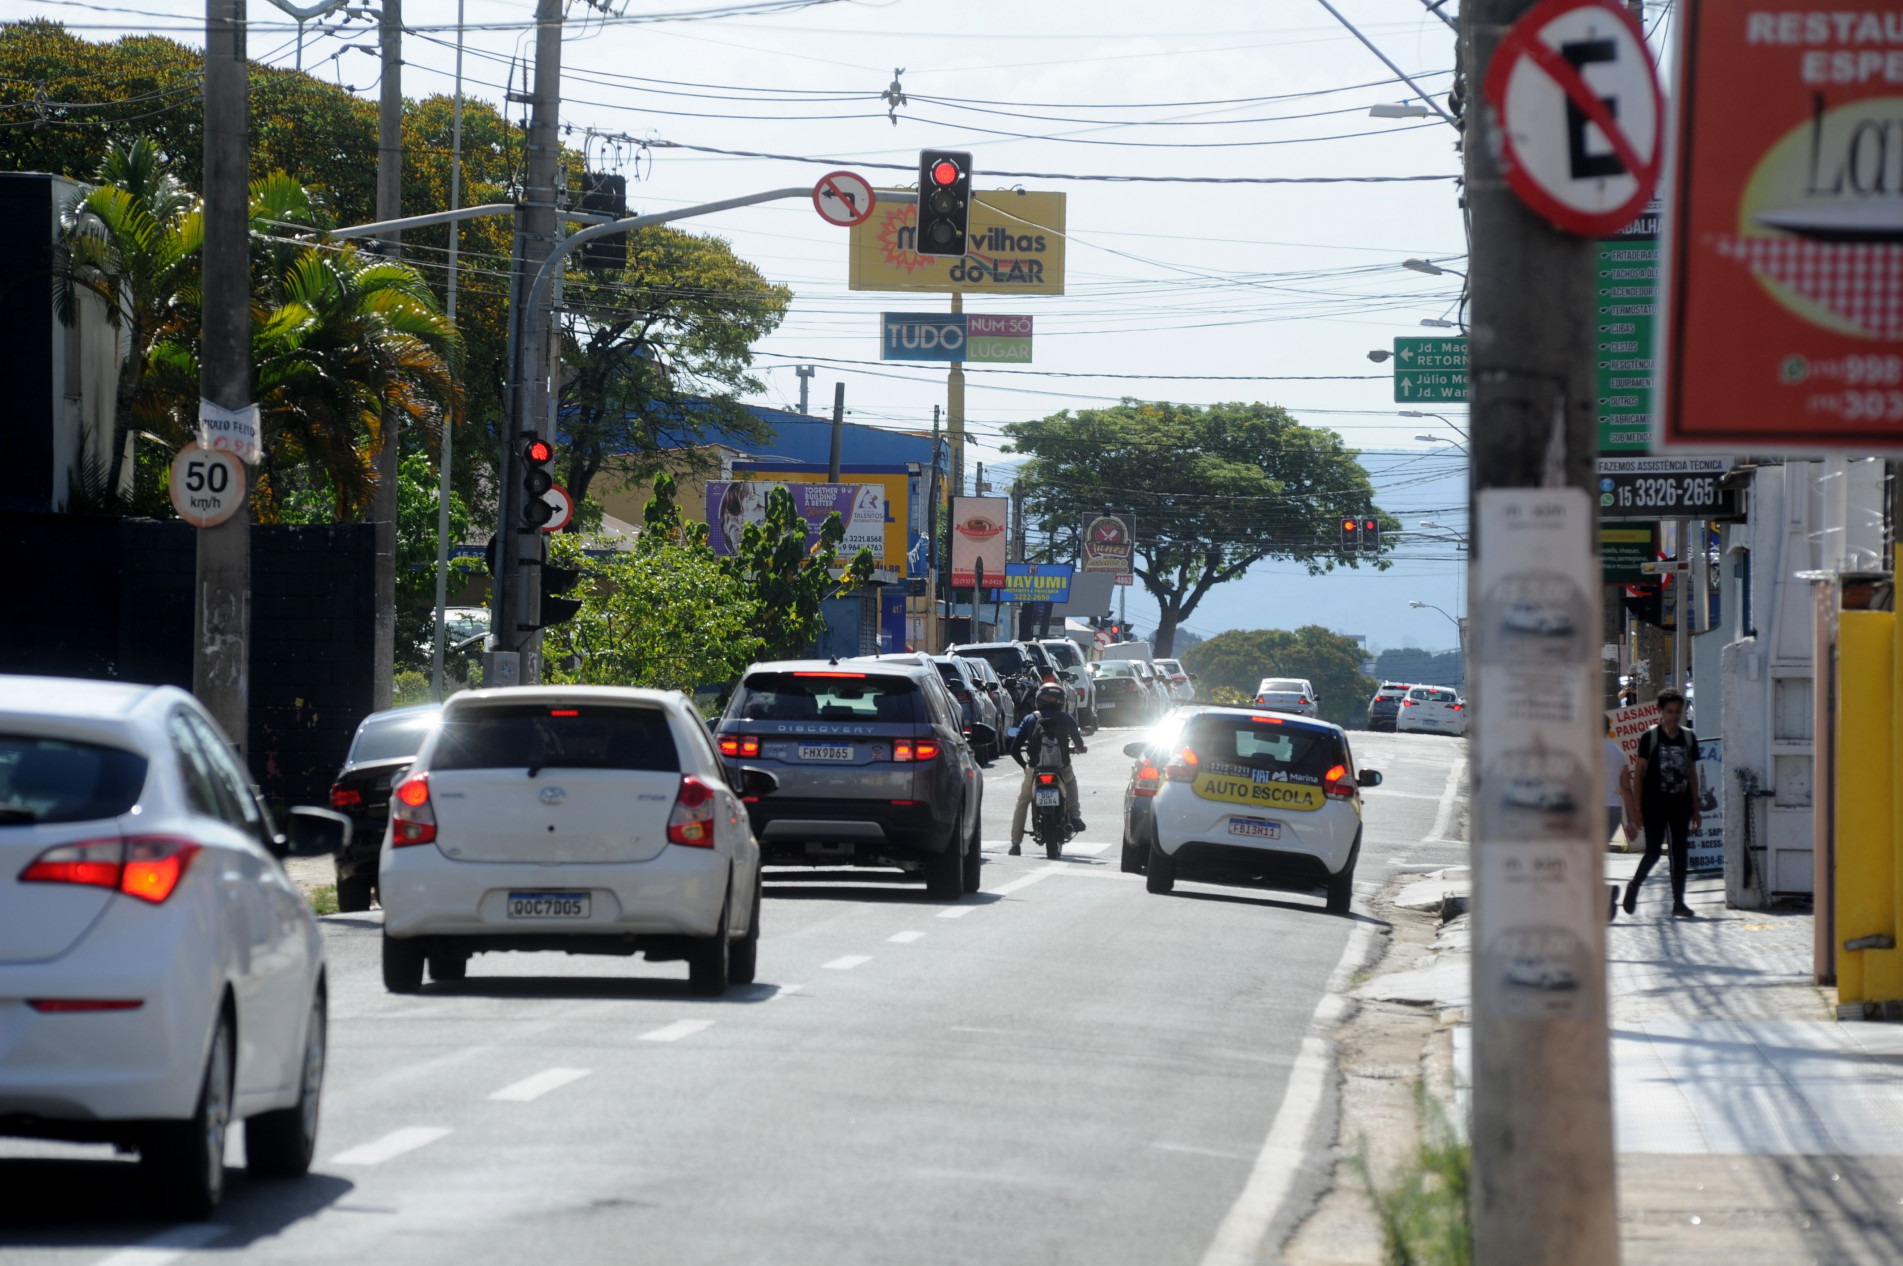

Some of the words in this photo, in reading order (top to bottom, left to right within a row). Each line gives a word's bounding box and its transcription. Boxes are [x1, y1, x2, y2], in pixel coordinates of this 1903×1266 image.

[1804, 92, 1903, 198] La
[896, 226, 1047, 254] mvilhas
[949, 258, 985, 283] do
[993, 259, 1045, 284] LAR
[1612, 269, 1639, 279] TACHOS
[971, 318, 1005, 333] NUM
[1009, 316, 1031, 333] SÓ
[1611, 324, 1635, 333] CUBAS
[887, 323, 964, 350] TUDO
[970, 342, 1030, 360] LUGAR
[1418, 342, 1436, 353] Jd.
[1611, 342, 1638, 351] CESTOS
[1416, 373, 1448, 384] Júlio
[1417, 387, 1435, 397] Jd.
[1611, 397, 1638, 406] OUTROS
[1611, 433, 1626, 442] SOB
[1598, 461, 1635, 472] FAZEMOS
[1637, 459, 1688, 471] ASSISTÊNCIA
[1690, 458, 1723, 470] TÉCNICA
[185, 461, 228, 493] 50
[805, 487, 838, 495] TOGETHER
[1618, 485, 1632, 507] 15
[190, 495, 220, 508] km/h
[850, 535, 883, 543] 3221.8568
[1005, 575, 1067, 589] MAYUMI
[777, 725, 875, 734] DISCOVERY
[1251, 768, 1270, 784] FIAT
[1290, 772, 1318, 783] Marina
[1205, 779, 1249, 797] AUTO
[1252, 785, 1314, 806] ESCOLA
